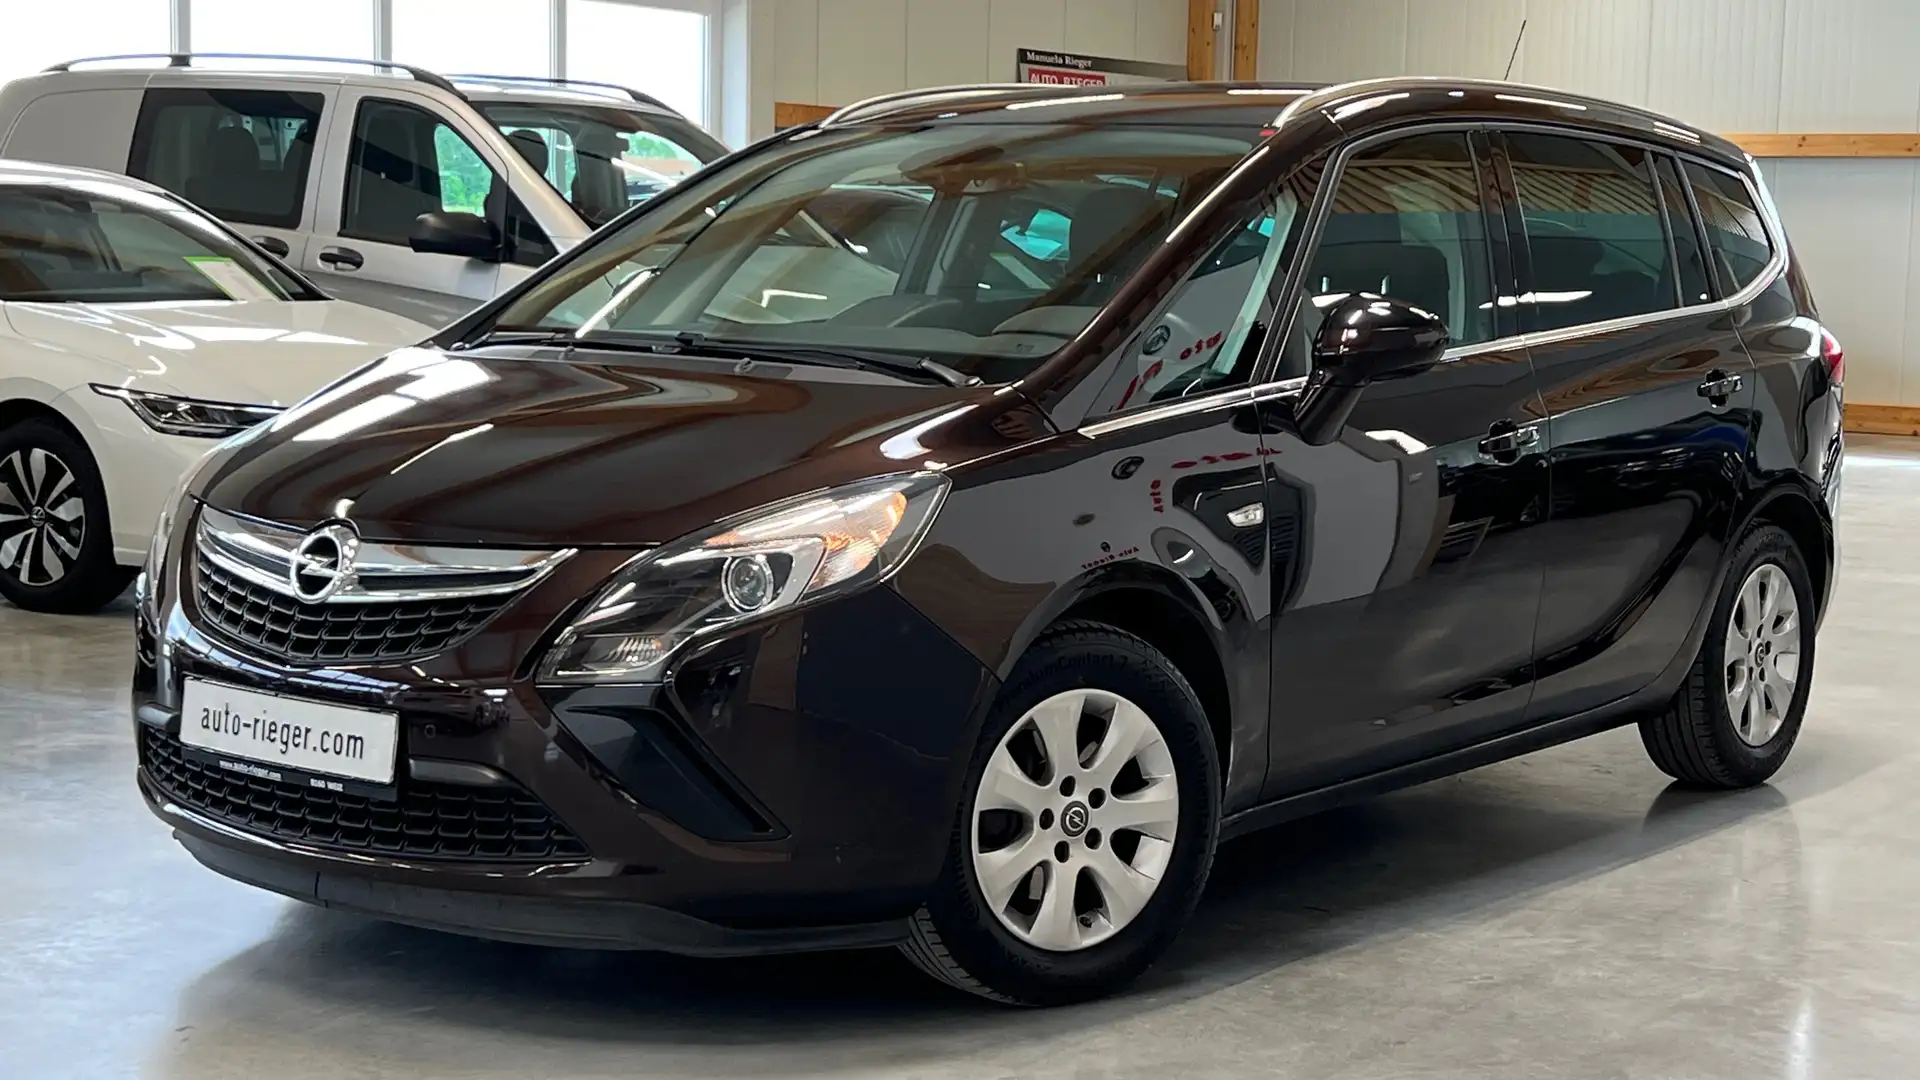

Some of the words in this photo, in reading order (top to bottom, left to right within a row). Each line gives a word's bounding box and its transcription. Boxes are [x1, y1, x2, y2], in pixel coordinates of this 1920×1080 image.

[1026, 51, 1063, 64] Manuela
[1065, 56, 1092, 69] Rieger
[1030, 73, 1058, 84] AUTO
[201, 703, 364, 759] auto-rieger.com
